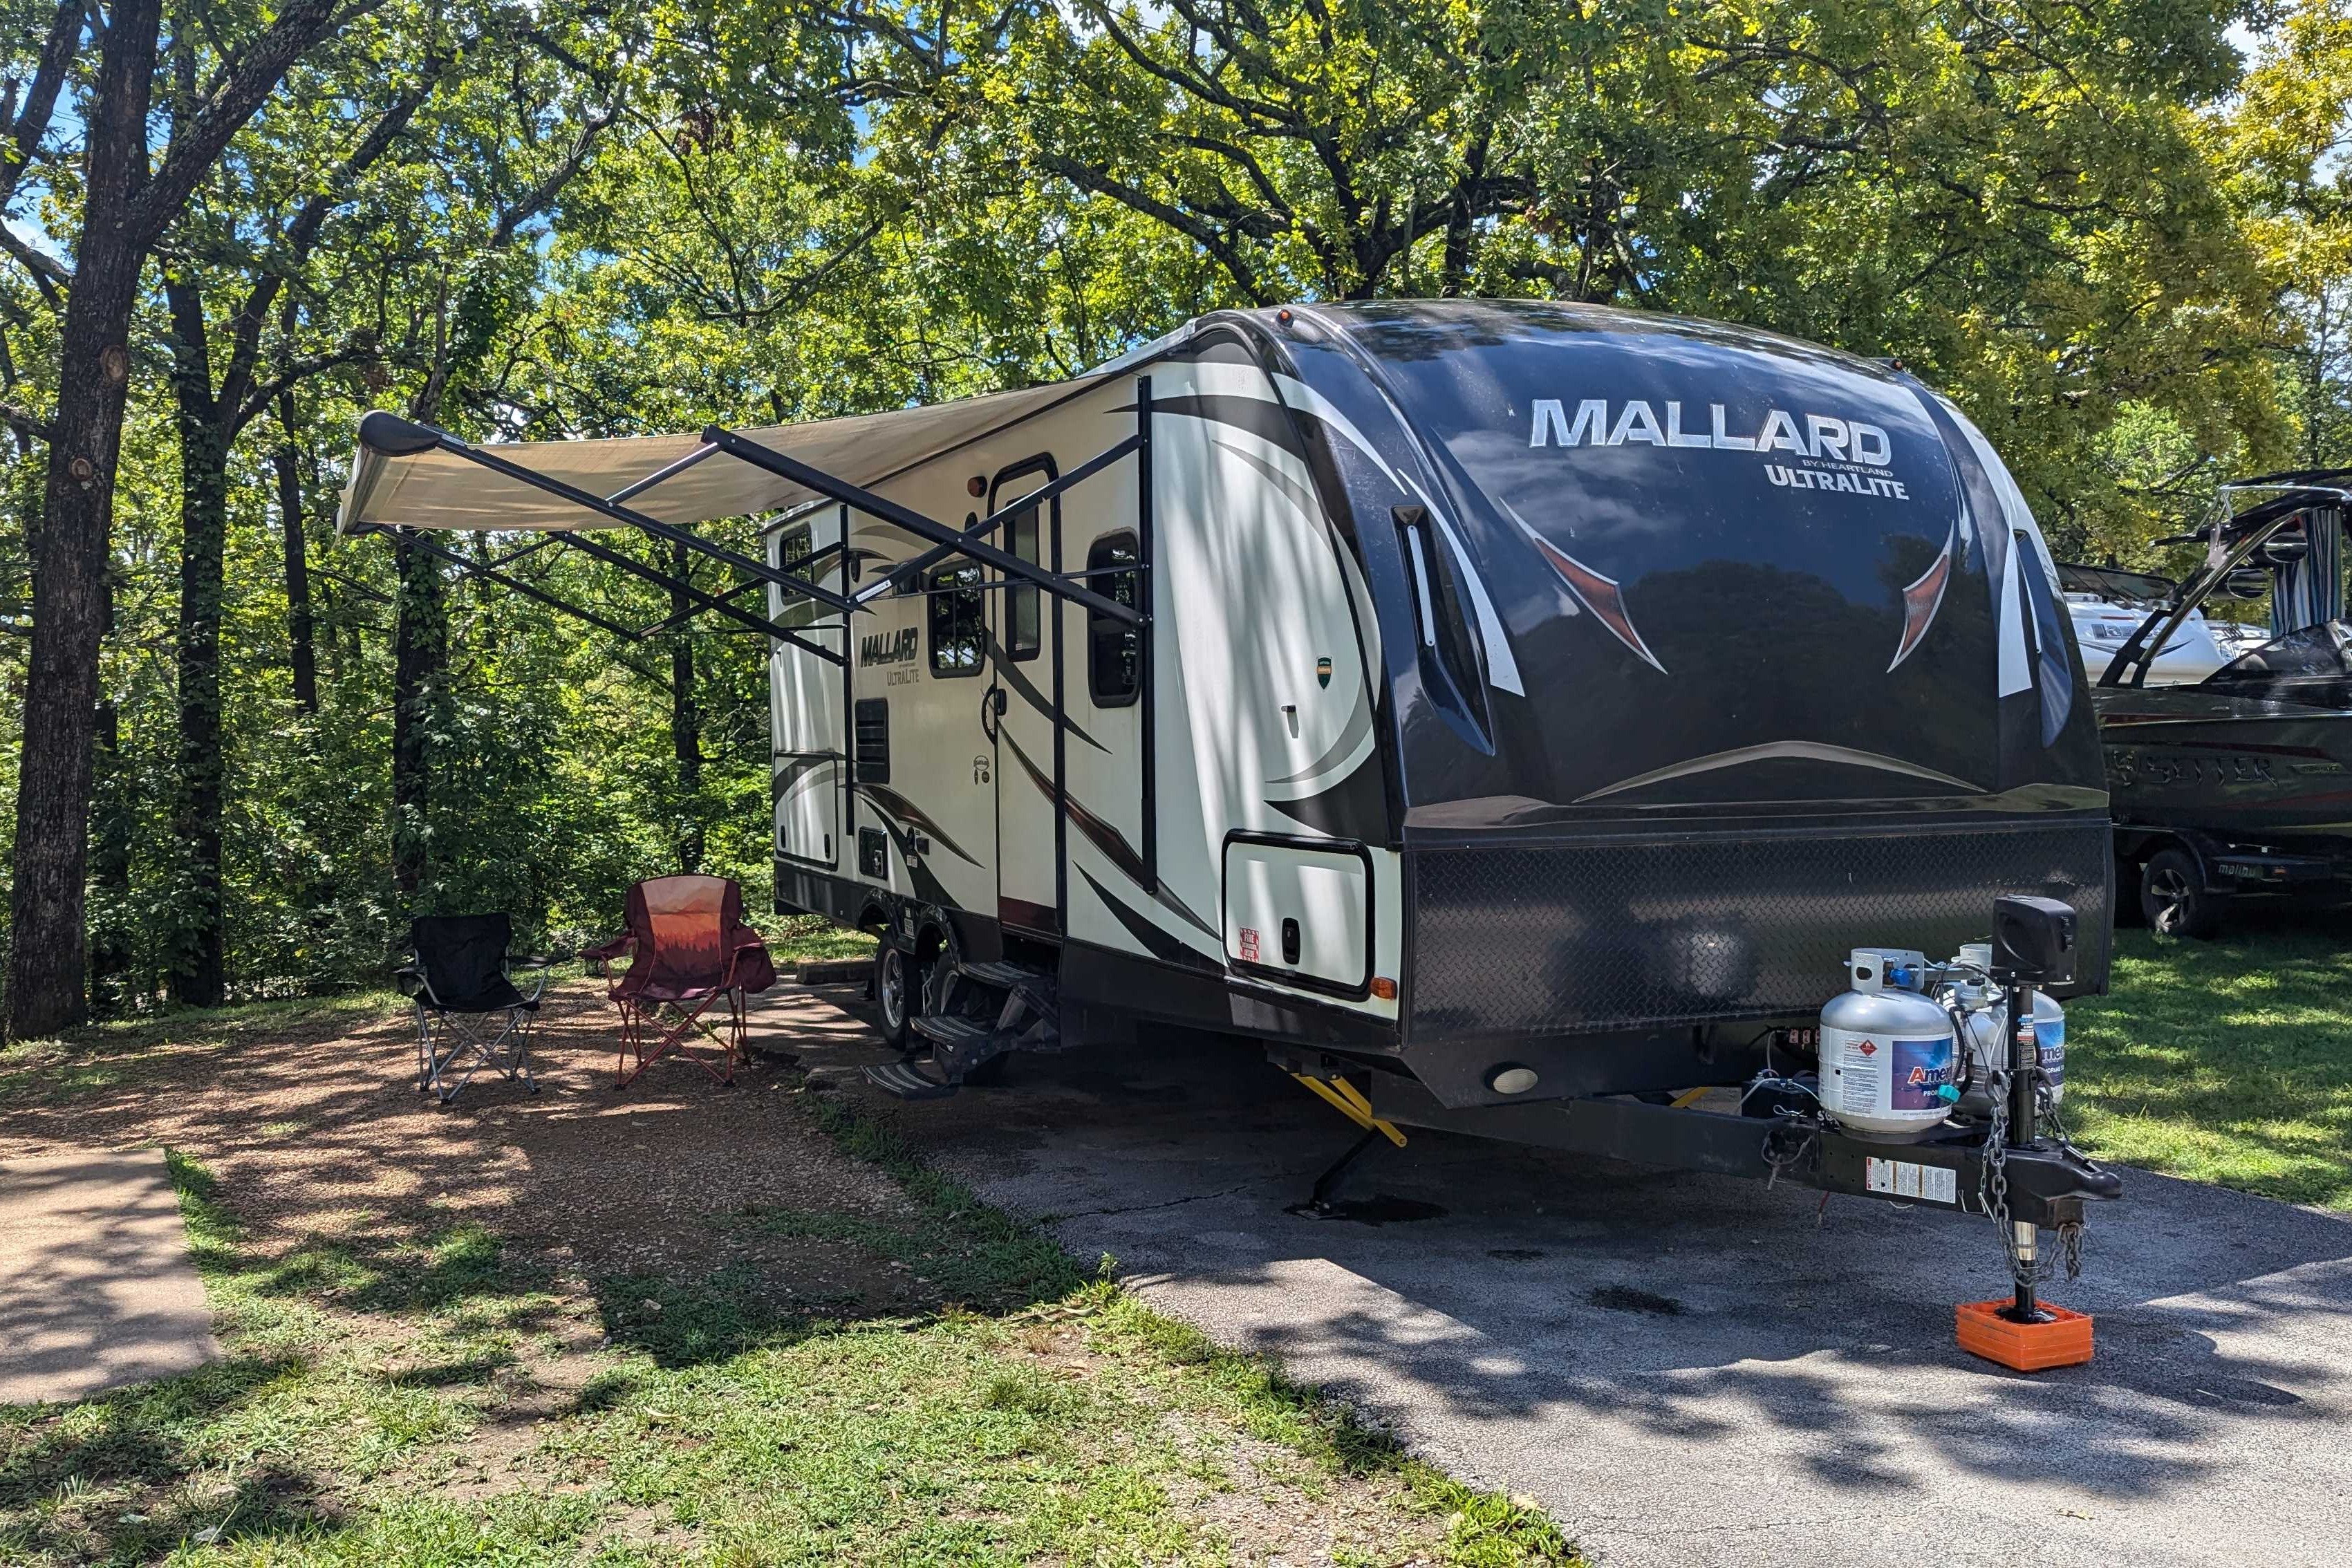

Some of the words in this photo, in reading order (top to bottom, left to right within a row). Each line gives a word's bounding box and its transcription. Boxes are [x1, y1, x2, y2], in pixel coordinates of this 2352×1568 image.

[1529, 399, 1892, 466] MALLARD
[1764, 464, 1910, 501] ULTRALITE
[1802, 459, 1819, 468] BY
[1822, 462, 1894, 477] HEARTLAND
[860, 626, 918, 668] MALLARD
[2219, 864, 2255, 877] malibu
